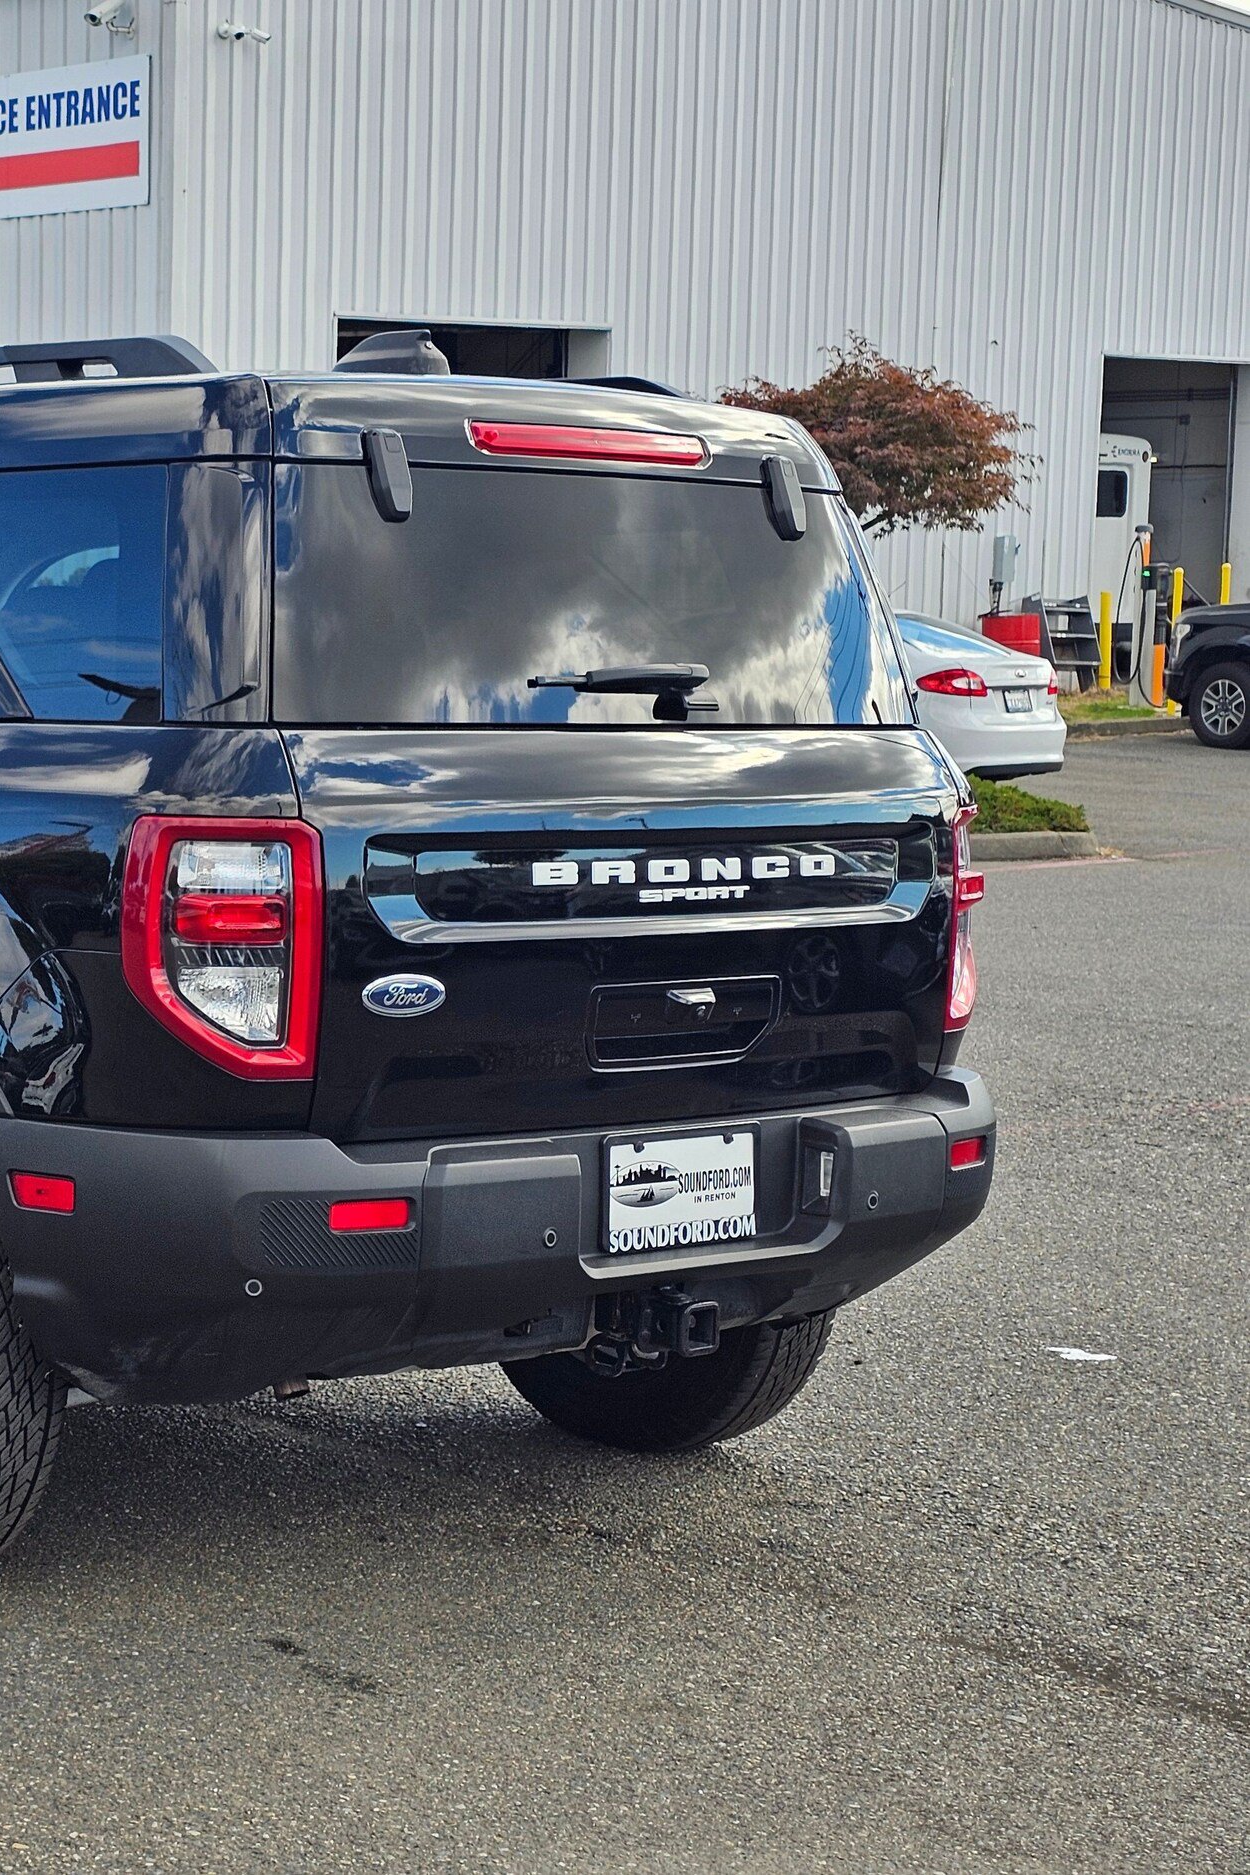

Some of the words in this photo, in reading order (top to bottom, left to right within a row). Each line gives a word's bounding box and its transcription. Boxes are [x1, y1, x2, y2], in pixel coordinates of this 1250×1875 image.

[26, 79, 140, 131] ENTRANCE
[532, 854, 835, 887] BRONCO
[639, 885, 750, 903] SPORT
[383, 982, 429, 1006] Ford
[678, 1166, 751, 1194] SOUNDFORD.COM
[704, 1192, 736, 1202] RENTON
[609, 1213, 757, 1253] SOUNDFORD.COM
